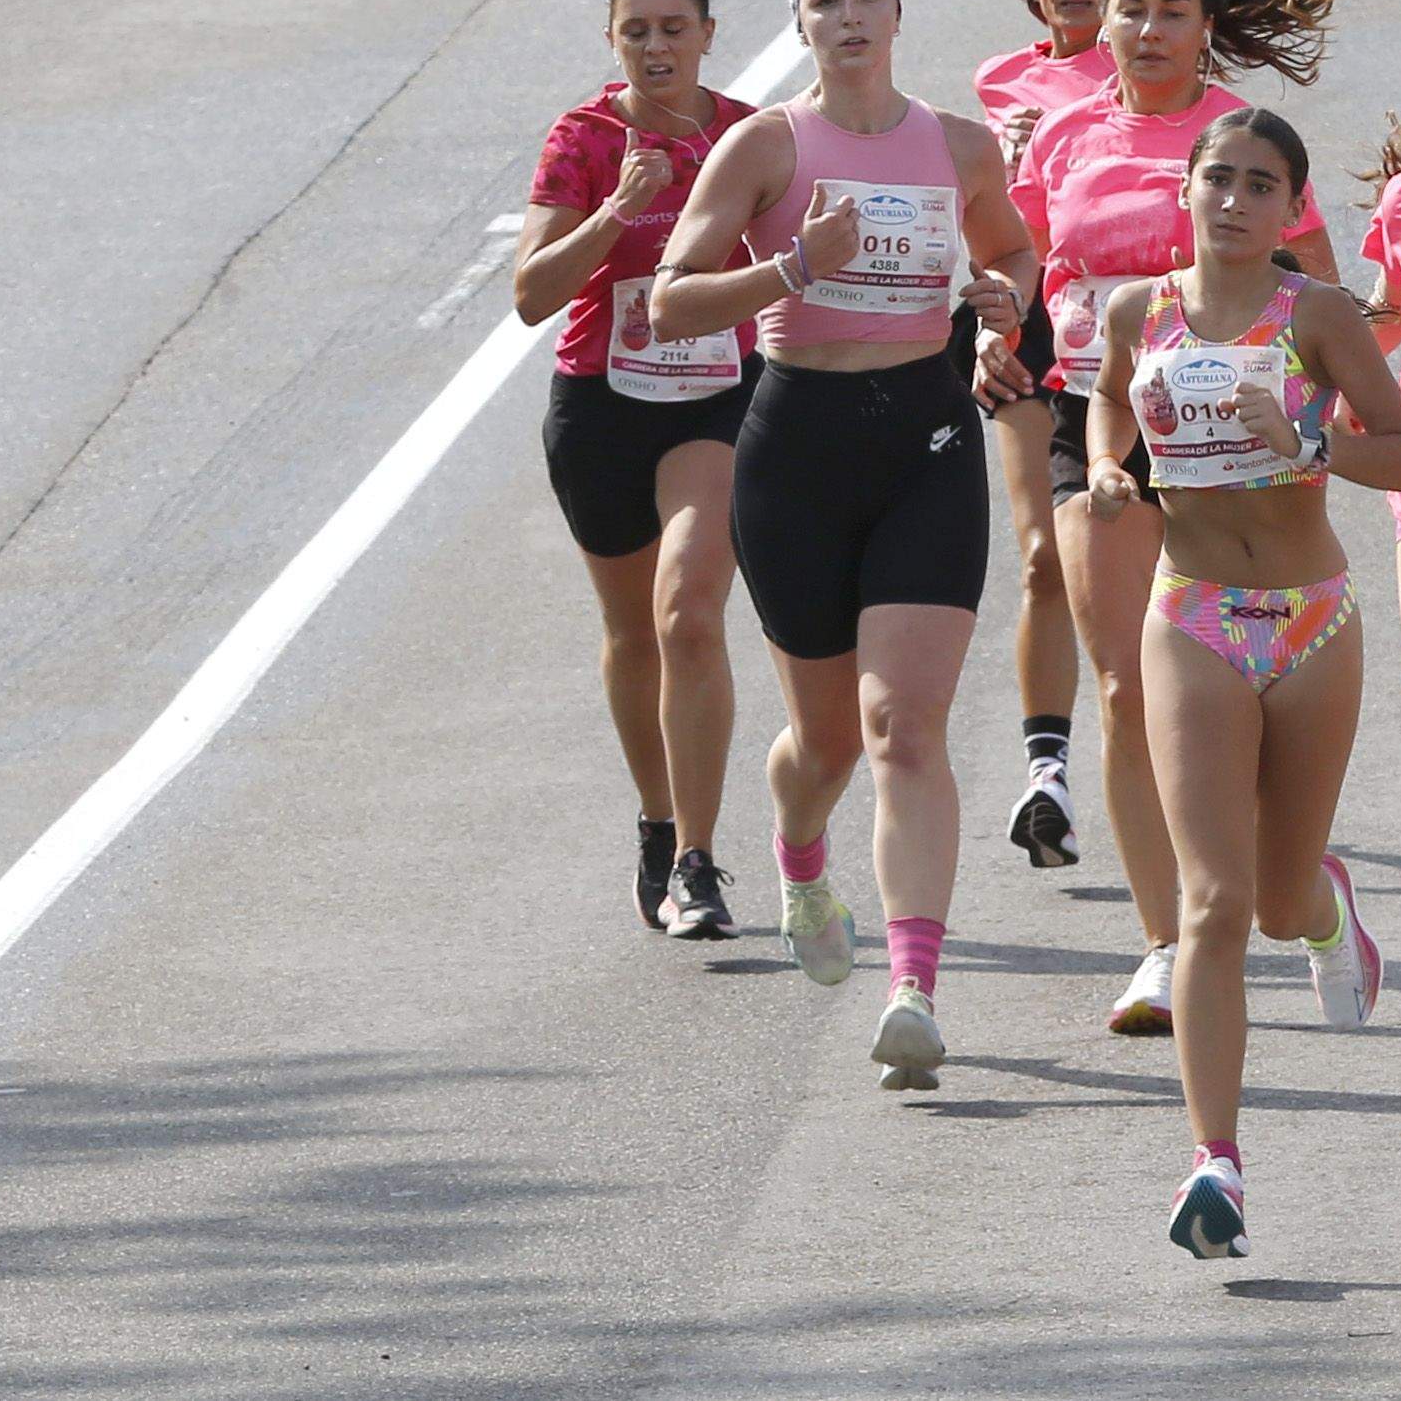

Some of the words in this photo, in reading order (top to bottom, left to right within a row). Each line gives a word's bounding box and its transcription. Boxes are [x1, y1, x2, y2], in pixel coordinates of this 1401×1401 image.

[634, 211, 675, 228] ports
[863, 235, 911, 255] 016
[869, 260, 900, 271] 4388
[819, 287, 864, 302] OYSHO
[660, 351, 690, 362] 2114
[1244, 363, 1273, 373] SUMA
[1177, 372, 1232, 384] ASTURIANA
[1206, 426, 1215, 438] 4
